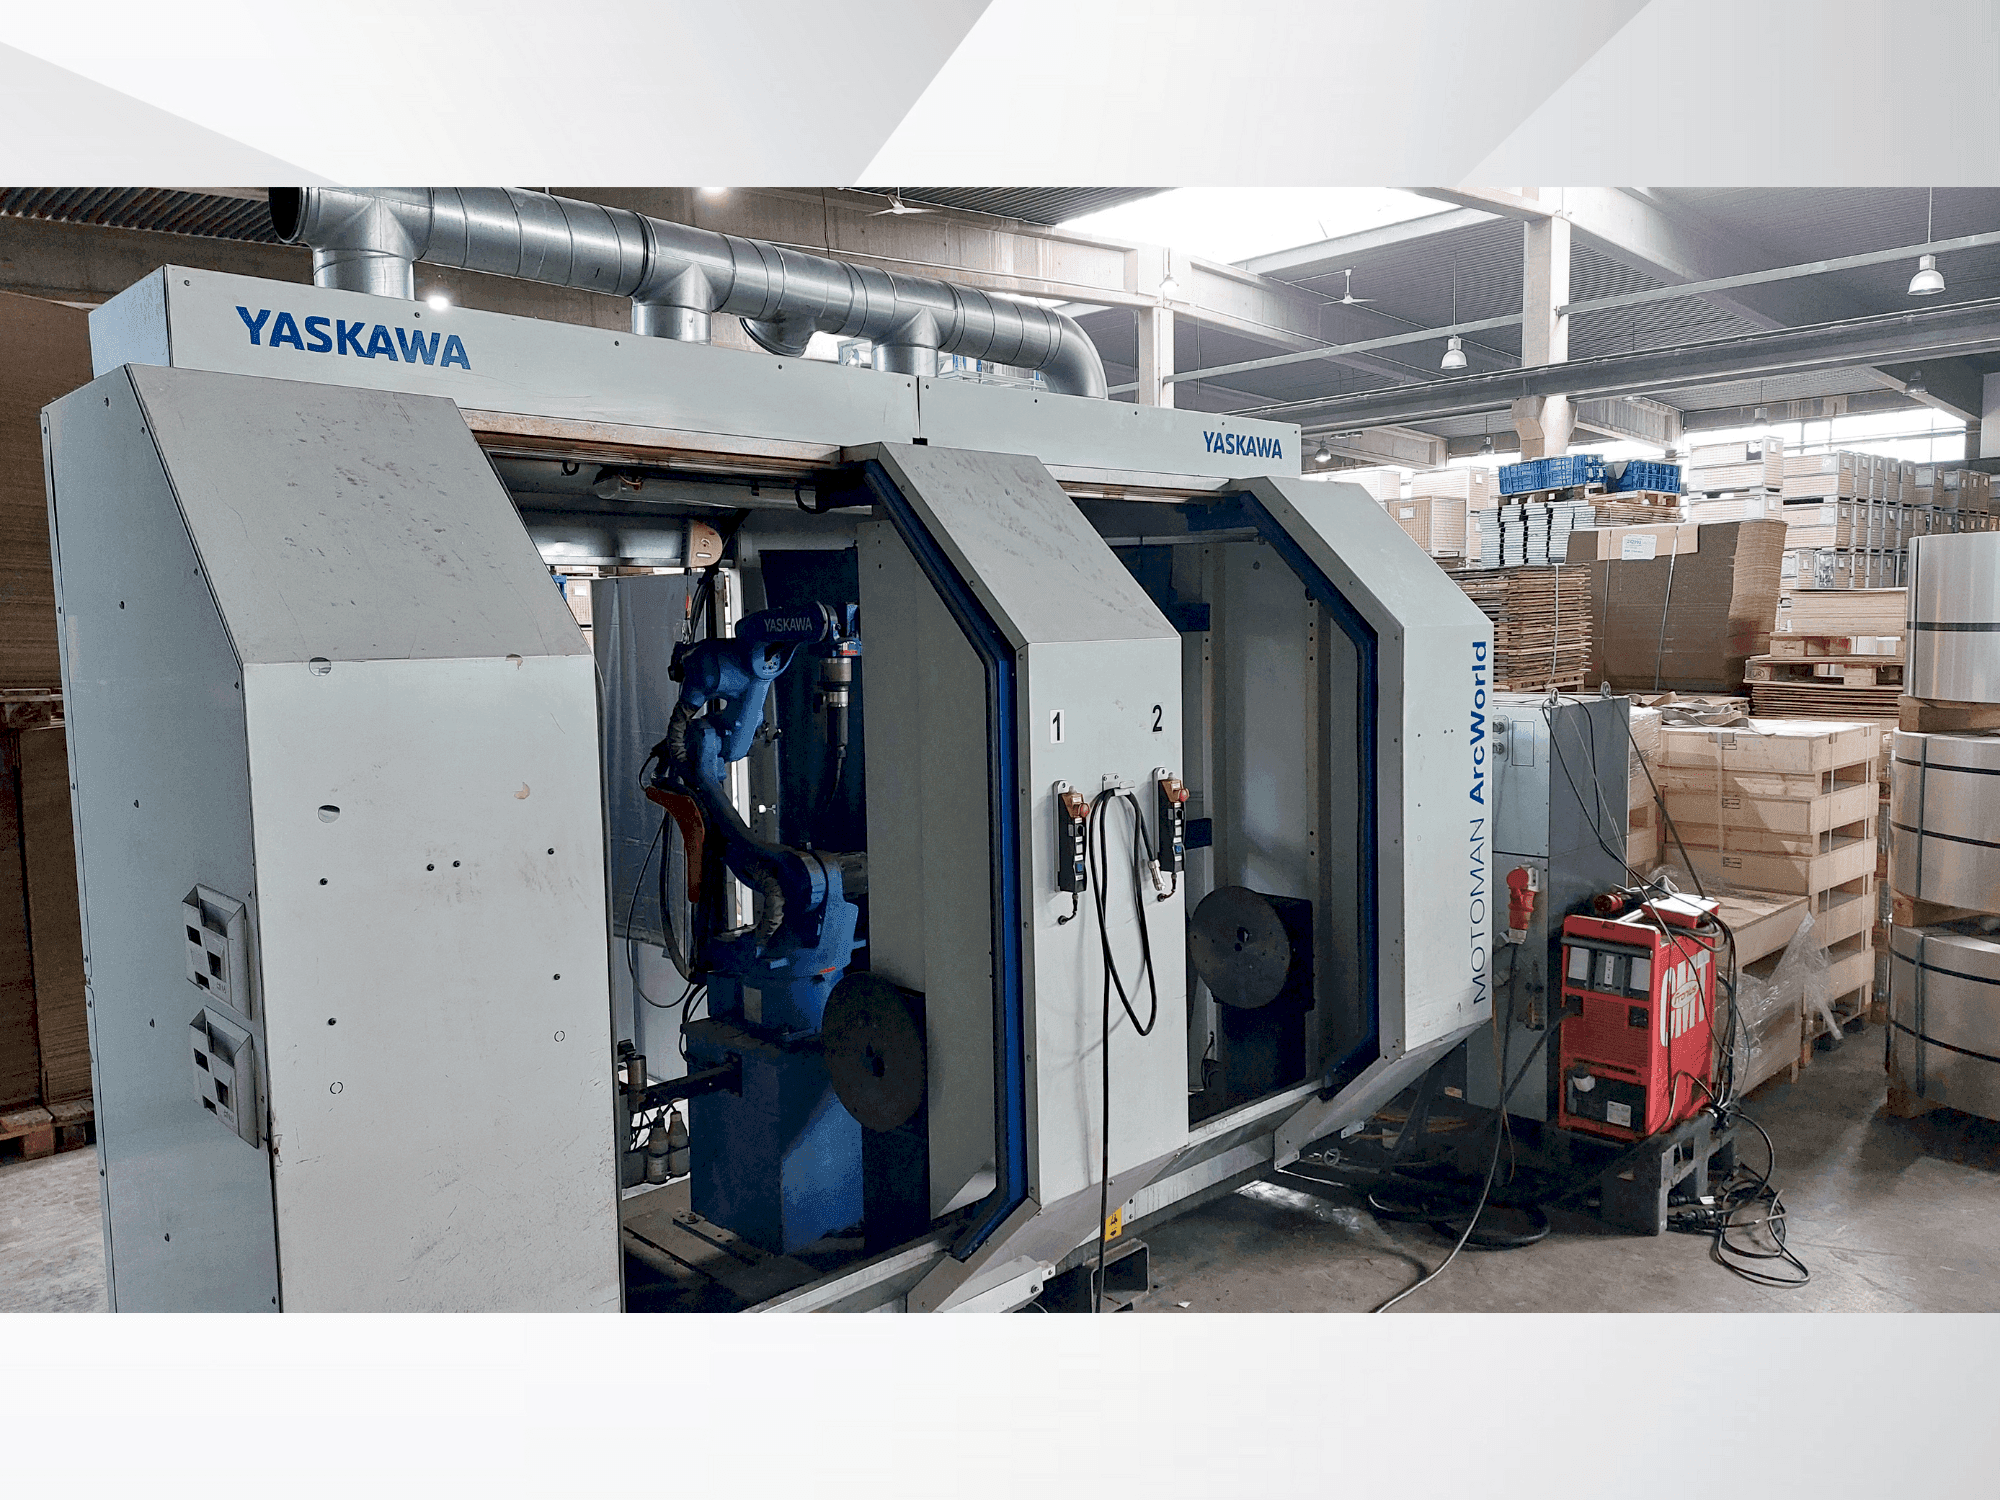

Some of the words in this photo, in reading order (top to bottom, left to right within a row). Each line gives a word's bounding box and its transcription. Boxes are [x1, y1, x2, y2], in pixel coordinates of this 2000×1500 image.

[235, 306, 471, 370] YASKAWA
[1203, 430, 1283, 459] YASKAWA
[764, 617, 812, 632] YASKAWA
[1052, 711, 1061, 741] 1
[1152, 704, 1163, 732] 2
[1469, 641, 1487, 805] ArcWorld
[1469, 817, 1487, 1005] MOTOMAN
